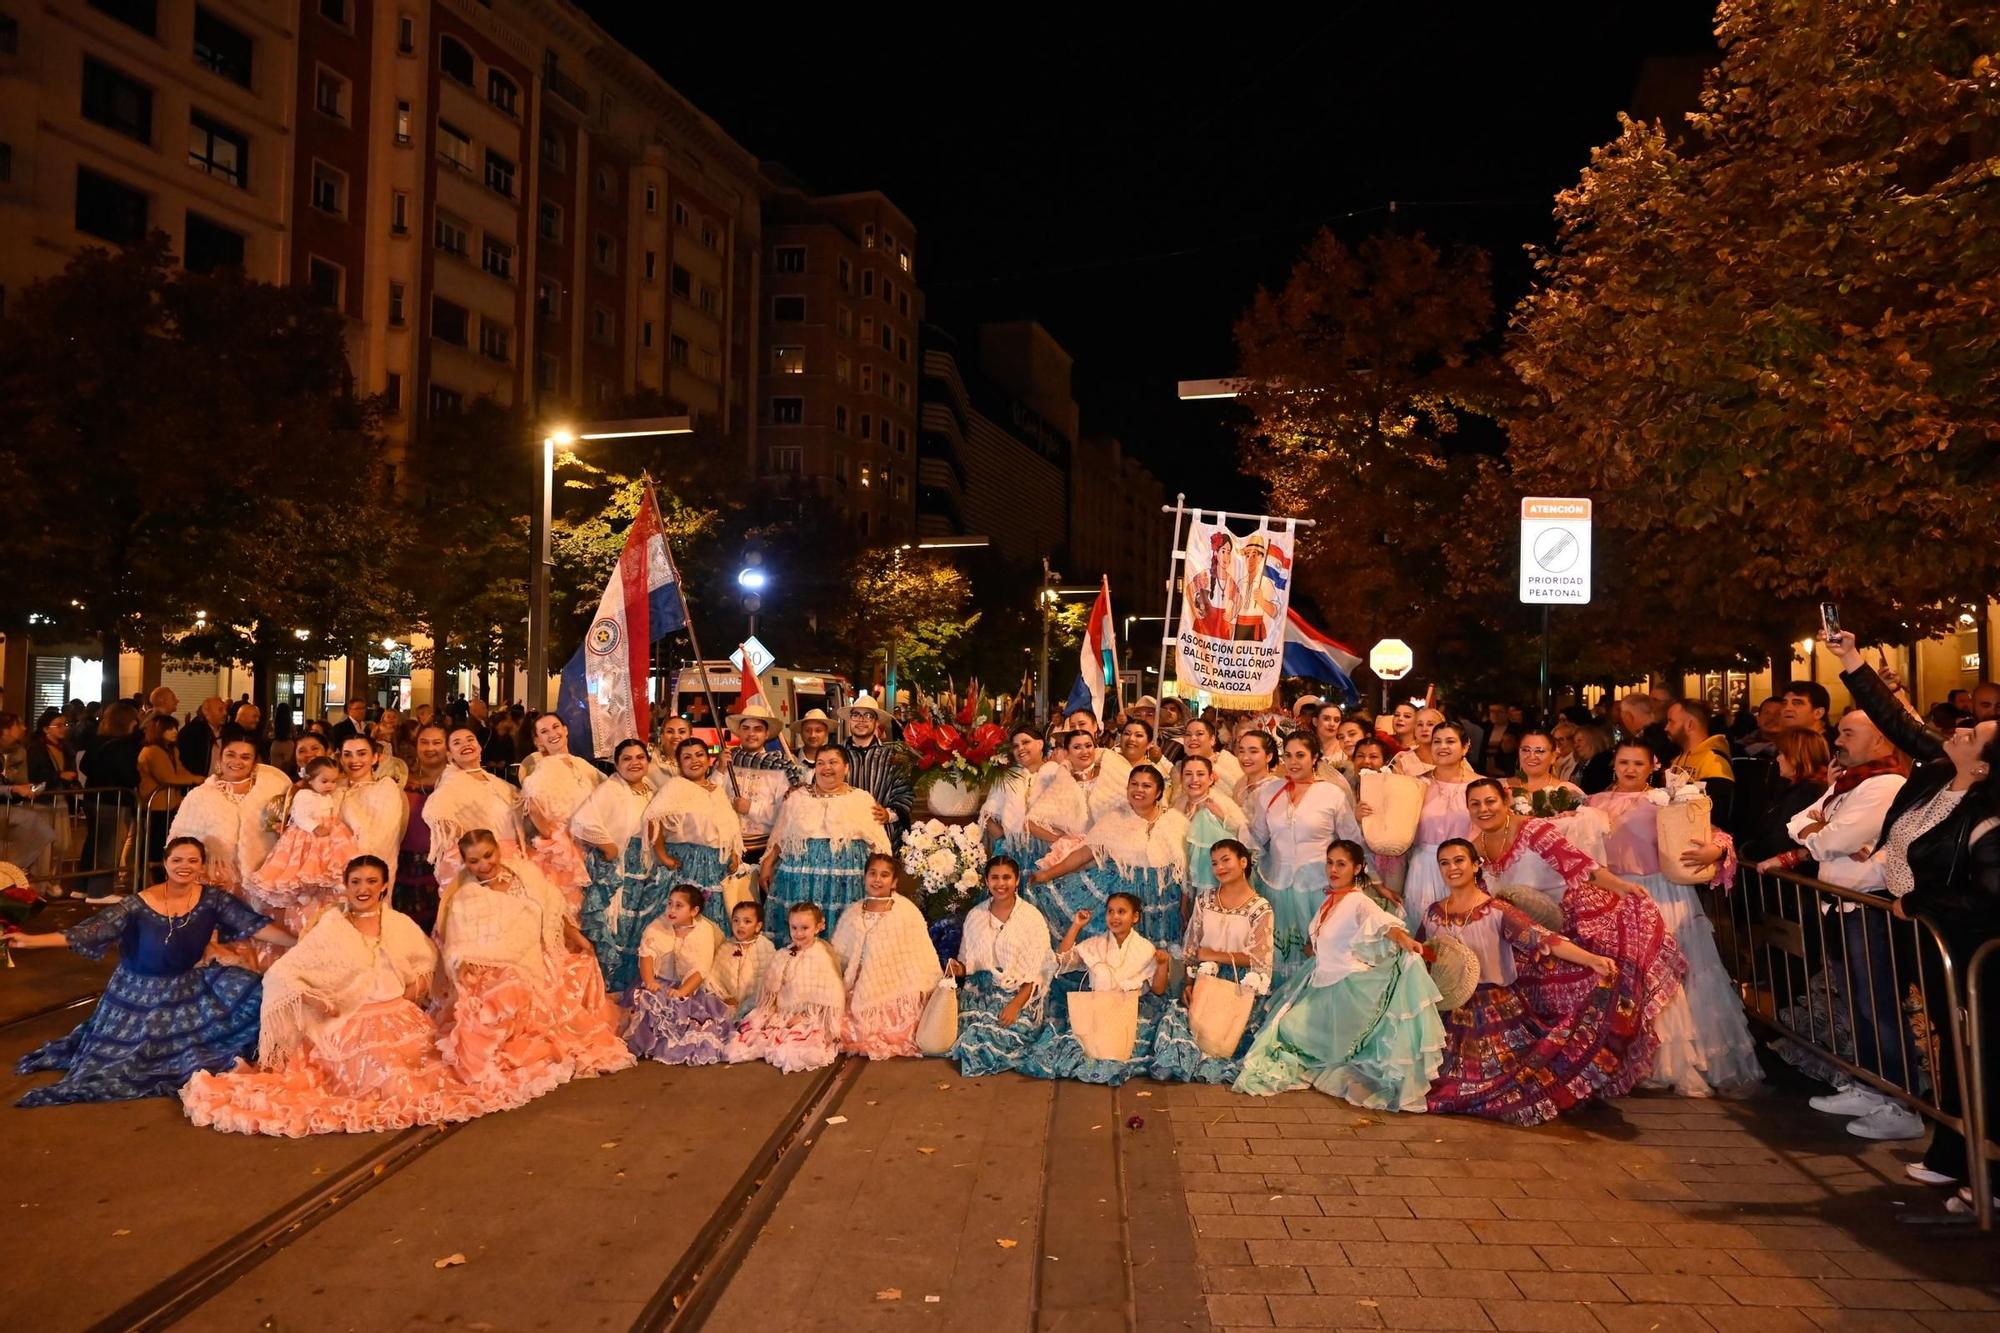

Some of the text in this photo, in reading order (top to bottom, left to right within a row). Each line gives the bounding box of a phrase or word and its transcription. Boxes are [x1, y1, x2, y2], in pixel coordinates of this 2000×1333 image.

[1529, 504, 1584, 514] ATENCIÓN
[1528, 576, 1584, 585] PRIORIDAD
[1529, 589, 1583, 597] PEATONAL
[1180, 633, 1234, 655] ASOCIACIÓN
[1183, 646, 1275, 668] BALLET FOLCLÓRICO
[1193, 662, 1263, 681] DEL PARAGUAY
[1200, 677, 1252, 692] ZARAGOZA
